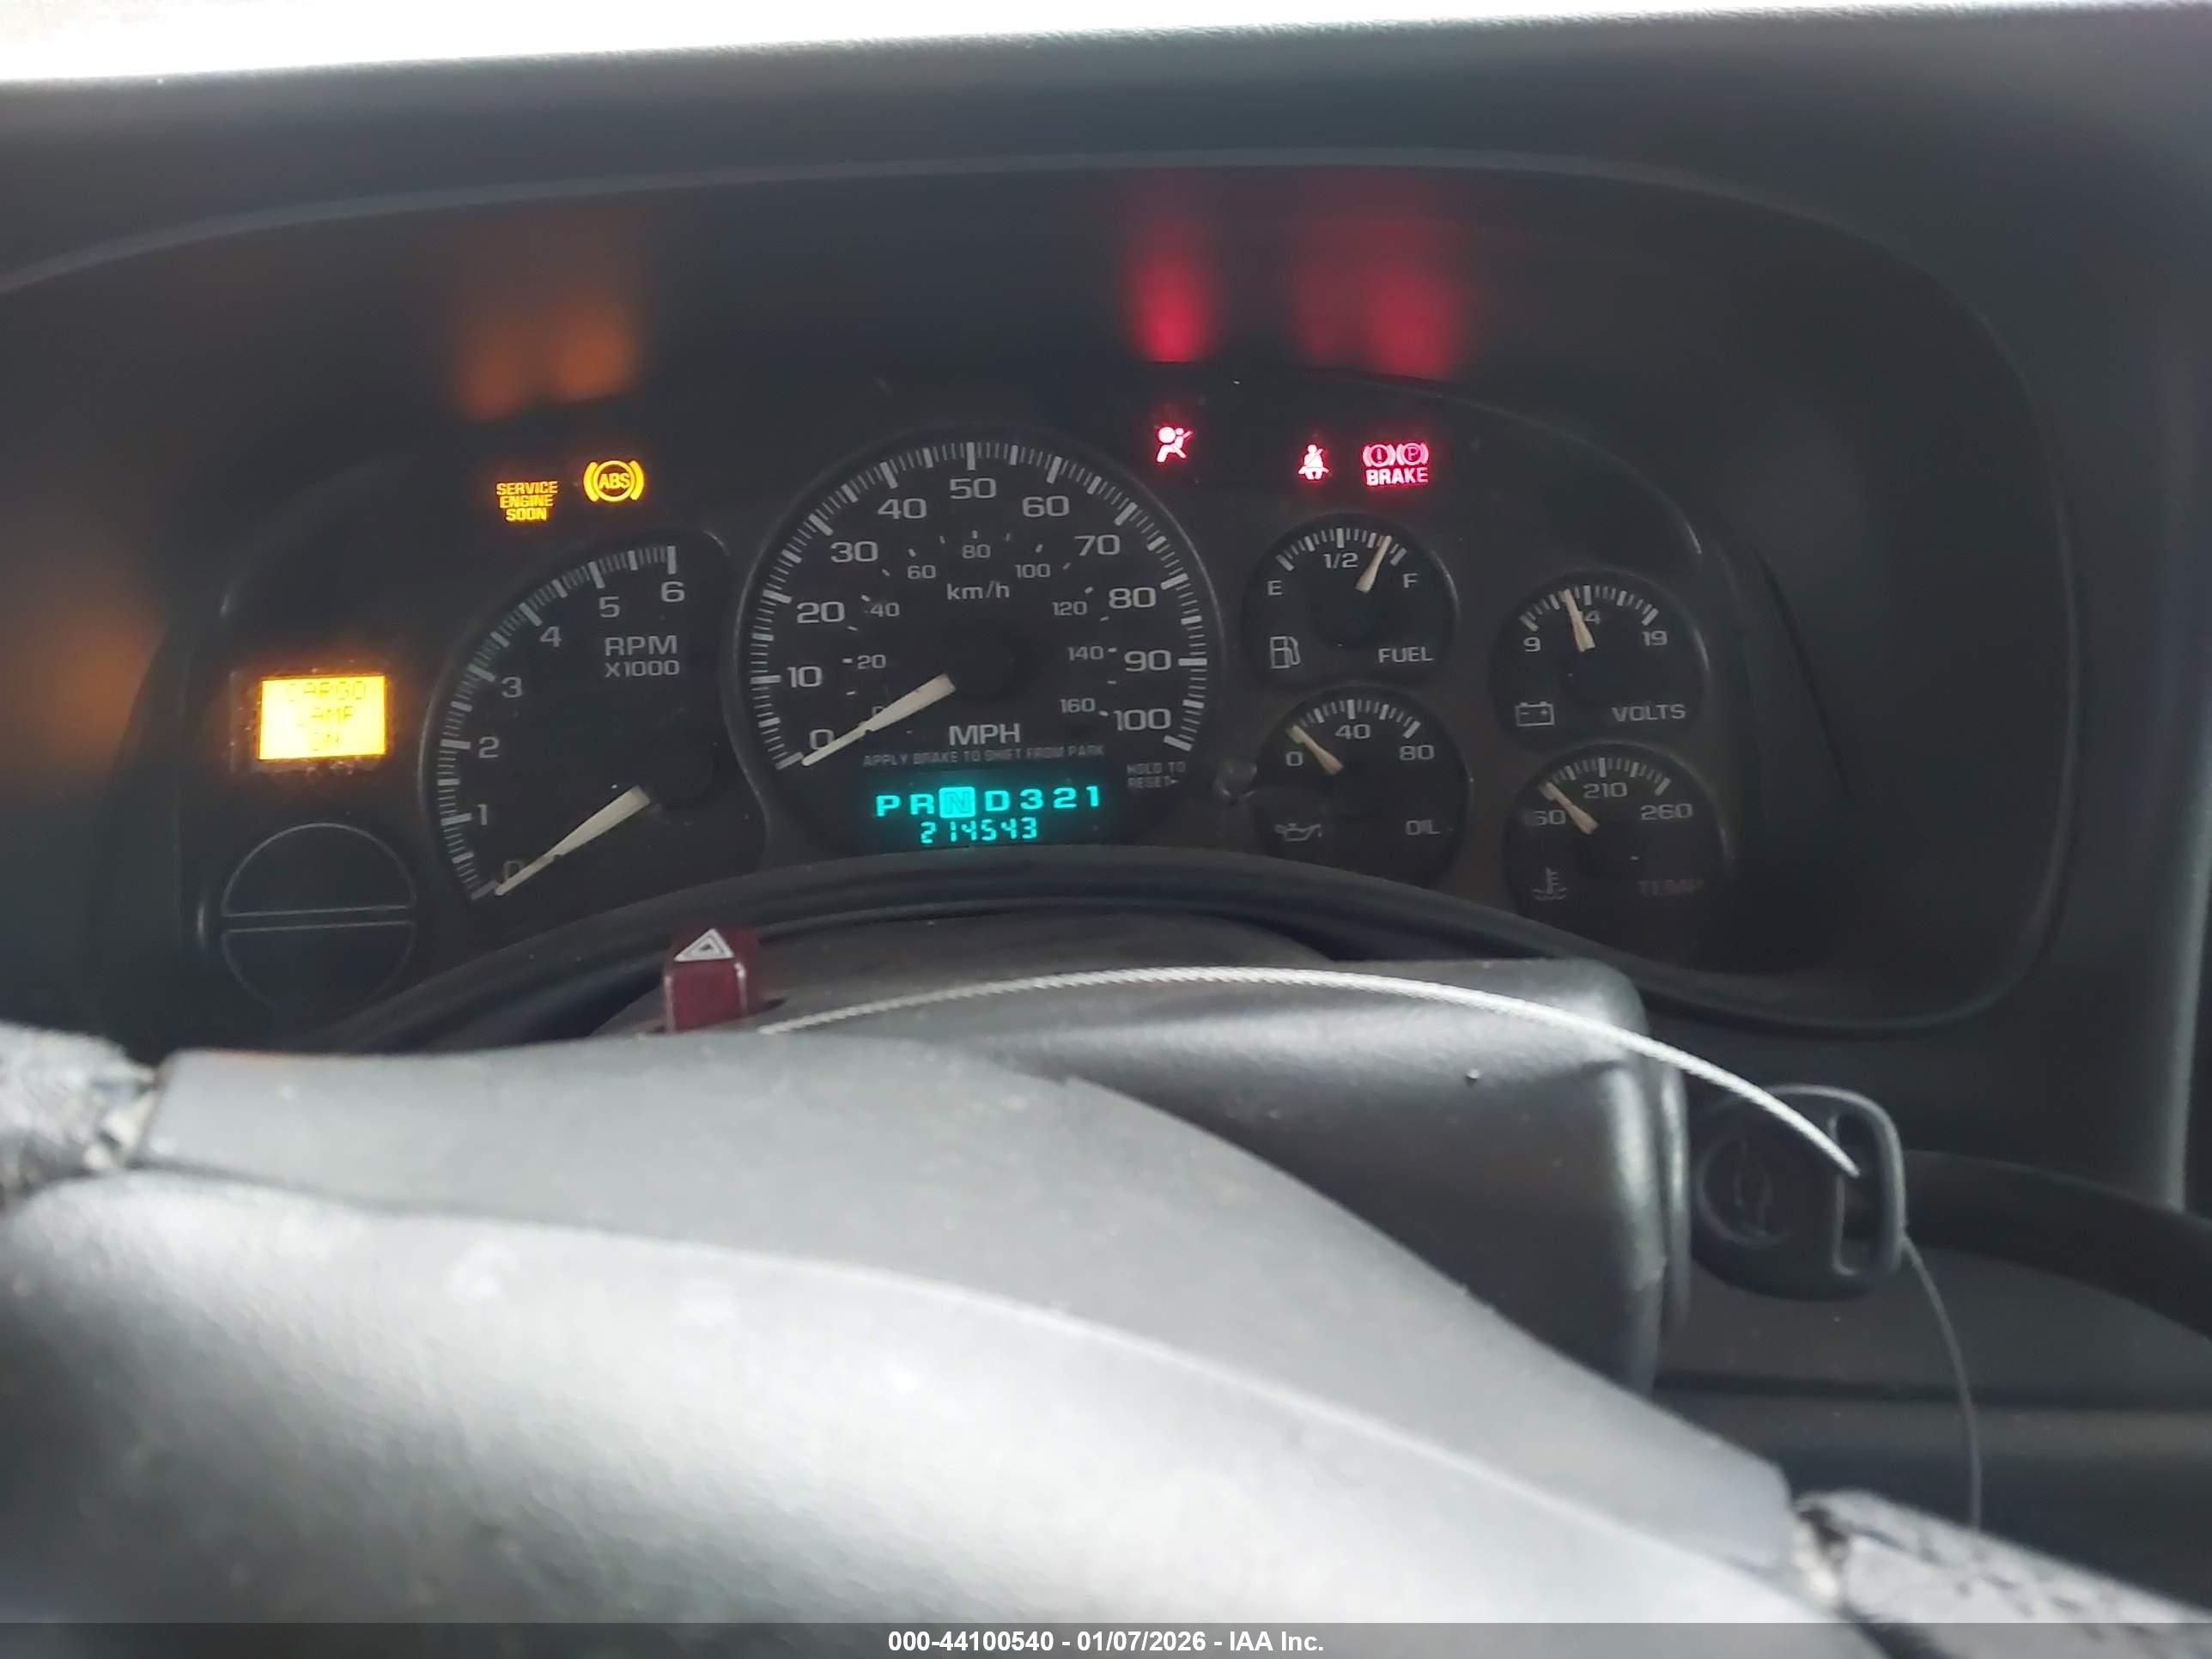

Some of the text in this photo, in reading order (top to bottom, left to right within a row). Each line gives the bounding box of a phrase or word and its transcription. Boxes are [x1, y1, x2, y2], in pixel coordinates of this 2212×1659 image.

[599, 473, 630, 489] ABS
[1366, 467, 1428, 486] BRAKE
[496, 481, 558, 495] SERVICE
[951, 478, 996, 499] 50
[500, 495, 553, 508] ENGINE
[878, 499, 927, 519] 40
[1023, 495, 1069, 517] 60
[506, 507, 546, 521] SOON
[831, 541, 878, 562] 30
[963, 544, 990, 558] 80
[1075, 535, 1120, 556] 70
[1324, 553, 1358, 568] 1/2
[908, 565, 936, 579] 60
[1016, 564, 1050, 578] 100
[1268, 580, 1282, 595] E
[1404, 574, 1417, 587] F
[662, 581, 684, 602] 6
[947, 581, 1009, 599] km/h
[1109, 587, 1156, 608] 80
[599, 597, 619, 617] 5
[797, 602, 844, 623] 20
[871, 603, 899, 617] 40
[1053, 601, 1087, 616] 120
[540, 625, 561, 647] 4
[1523, 637, 1540, 652] 9
[1642, 631, 1668, 646] 19
[605, 635, 677, 656] RPM
[1069, 646, 1103, 660] 140
[858, 654, 886, 669] 20
[1125, 650, 1171, 672] 90
[1379, 647, 1432, 663] FUEL
[605, 660, 679, 678] X1000
[788, 666, 822, 687] 10
[502, 677, 522, 697] 3
[1060, 698, 1095, 713] 160
[1613, 704, 1685, 721] VOLTS
[1115, 708, 1170, 731] 100
[809, 728, 834, 750] 0
[950, 724, 1019, 745] MPH
[1335, 724, 1370, 739] 40
[479, 737, 499, 758] 2
[862, 754, 907, 767] APPLY
[913, 751, 957, 765] BRAKE
[964, 750, 980, 763] TO
[1068, 744, 1103, 757] PARK
[1400, 745, 1434, 760] 80
[1286, 751, 1303, 766] 0
[1127, 762, 1186, 775] HOLD TO
[1127, 776, 1171, 788] RESET
[1583, 782, 1628, 799] 210
[478, 804, 487, 825] 1
[1641, 804, 1693, 820] 260
[920, 817, 1037, 844] 214543
[1406, 820, 1439, 835] OIL
